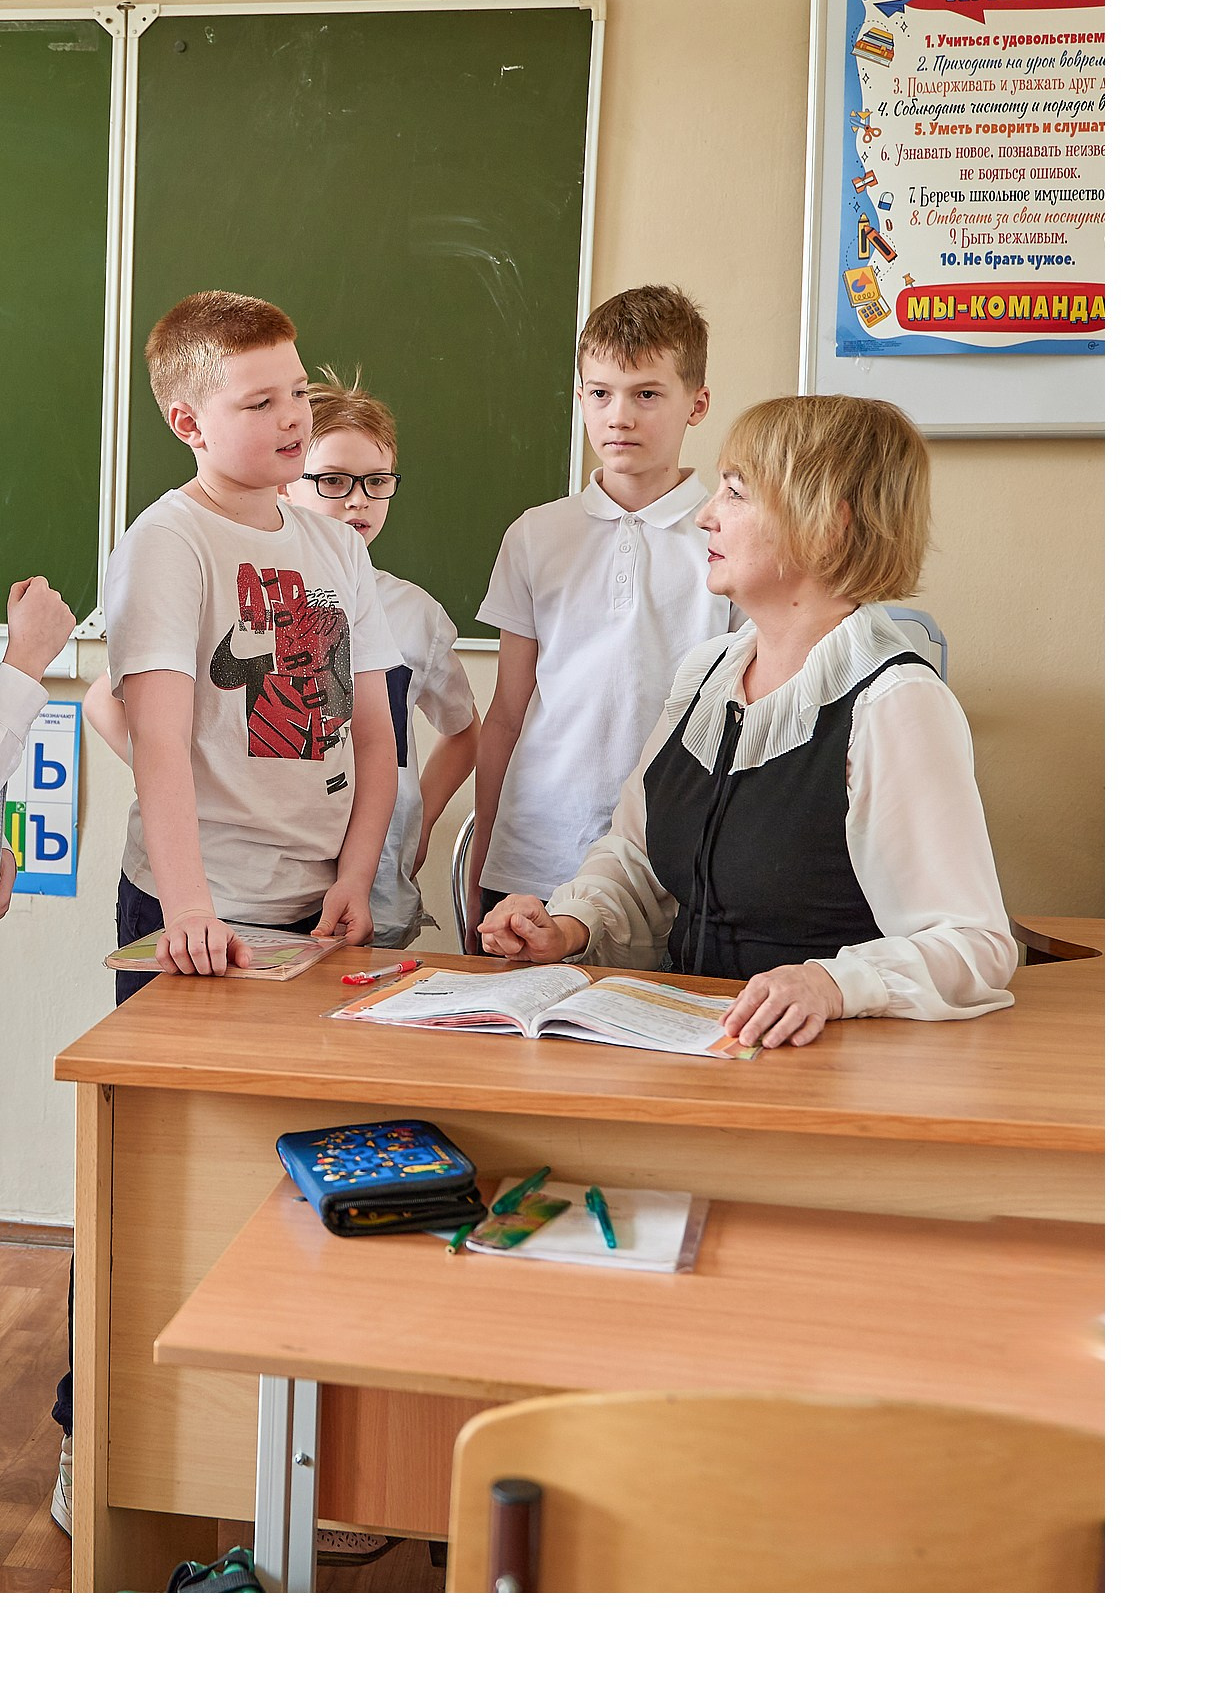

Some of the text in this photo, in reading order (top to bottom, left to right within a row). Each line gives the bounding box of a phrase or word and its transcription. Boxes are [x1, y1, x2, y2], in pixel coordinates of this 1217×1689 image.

[925, 35, 934, 48] 1.
[938, 34, 990, 47] Учиться
[993, 35, 1000, 45] с
[917, 56, 928, 71] 2.
[933, 55, 1002, 76] Приходить
[1006, 58, 1023, 68] на
[1024, 56, 1055, 74] урок
[893, 77, 903, 94] 3.
[907, 77, 995, 97] Поддерживать
[1000, 79, 1008, 91] и
[1010, 78, 1064, 95] уважать
[1069, 77, 1097, 94] друг
[878, 102, 888, 116] 4.
[894, 98, 965, 121] Соблюдать
[971, 101, 1029, 119] чистоту
[1032, 101, 1040, 112] и
[1043, 100, 1095, 118] порядок
[914, 122, 926, 136] 5.
[929, 122, 973, 136] Уметь
[975, 122, 1040, 138] говорить
[1043, 122, 1051, 133] и
[880, 143, 890, 161] 6.
[894, 143, 952, 167] Узнавать
[998, 145, 1062, 158] познавать
[960, 167, 1081, 183] не бояться ошибок.
[909, 186, 1105, 207] 7. Беречь школьное имущество
[910, 210, 921, 226] 8.
[926, 207, 993, 226] Отвечать
[993, 213, 1009, 230] за
[1013, 206, 1041, 223] свои
[961, 228, 994, 249] Быть
[998, 232, 1068, 245] вежливым.
[940, 251, 1076, 270] 10. Не брать чужое.
[33, 742, 67, 790] Ь
[29, 814, 69, 861] Ъ
